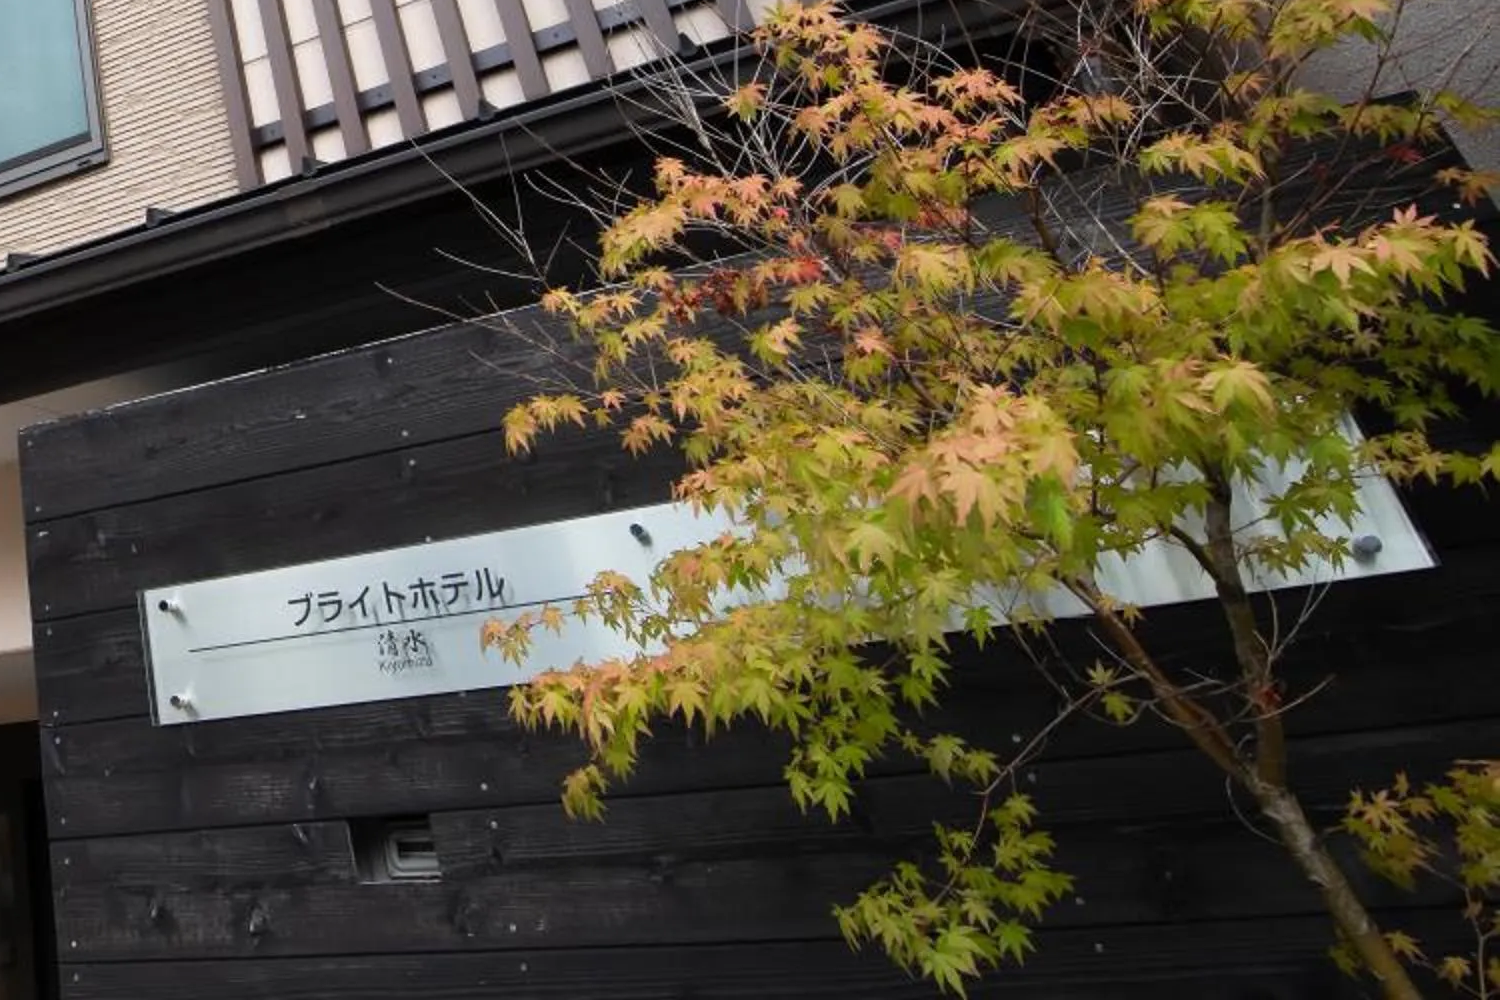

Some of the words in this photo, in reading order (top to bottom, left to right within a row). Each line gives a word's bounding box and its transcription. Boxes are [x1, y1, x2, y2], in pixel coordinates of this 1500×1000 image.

[288, 567, 505, 627] ブライトホテル
[377, 629, 428, 656] 清水
